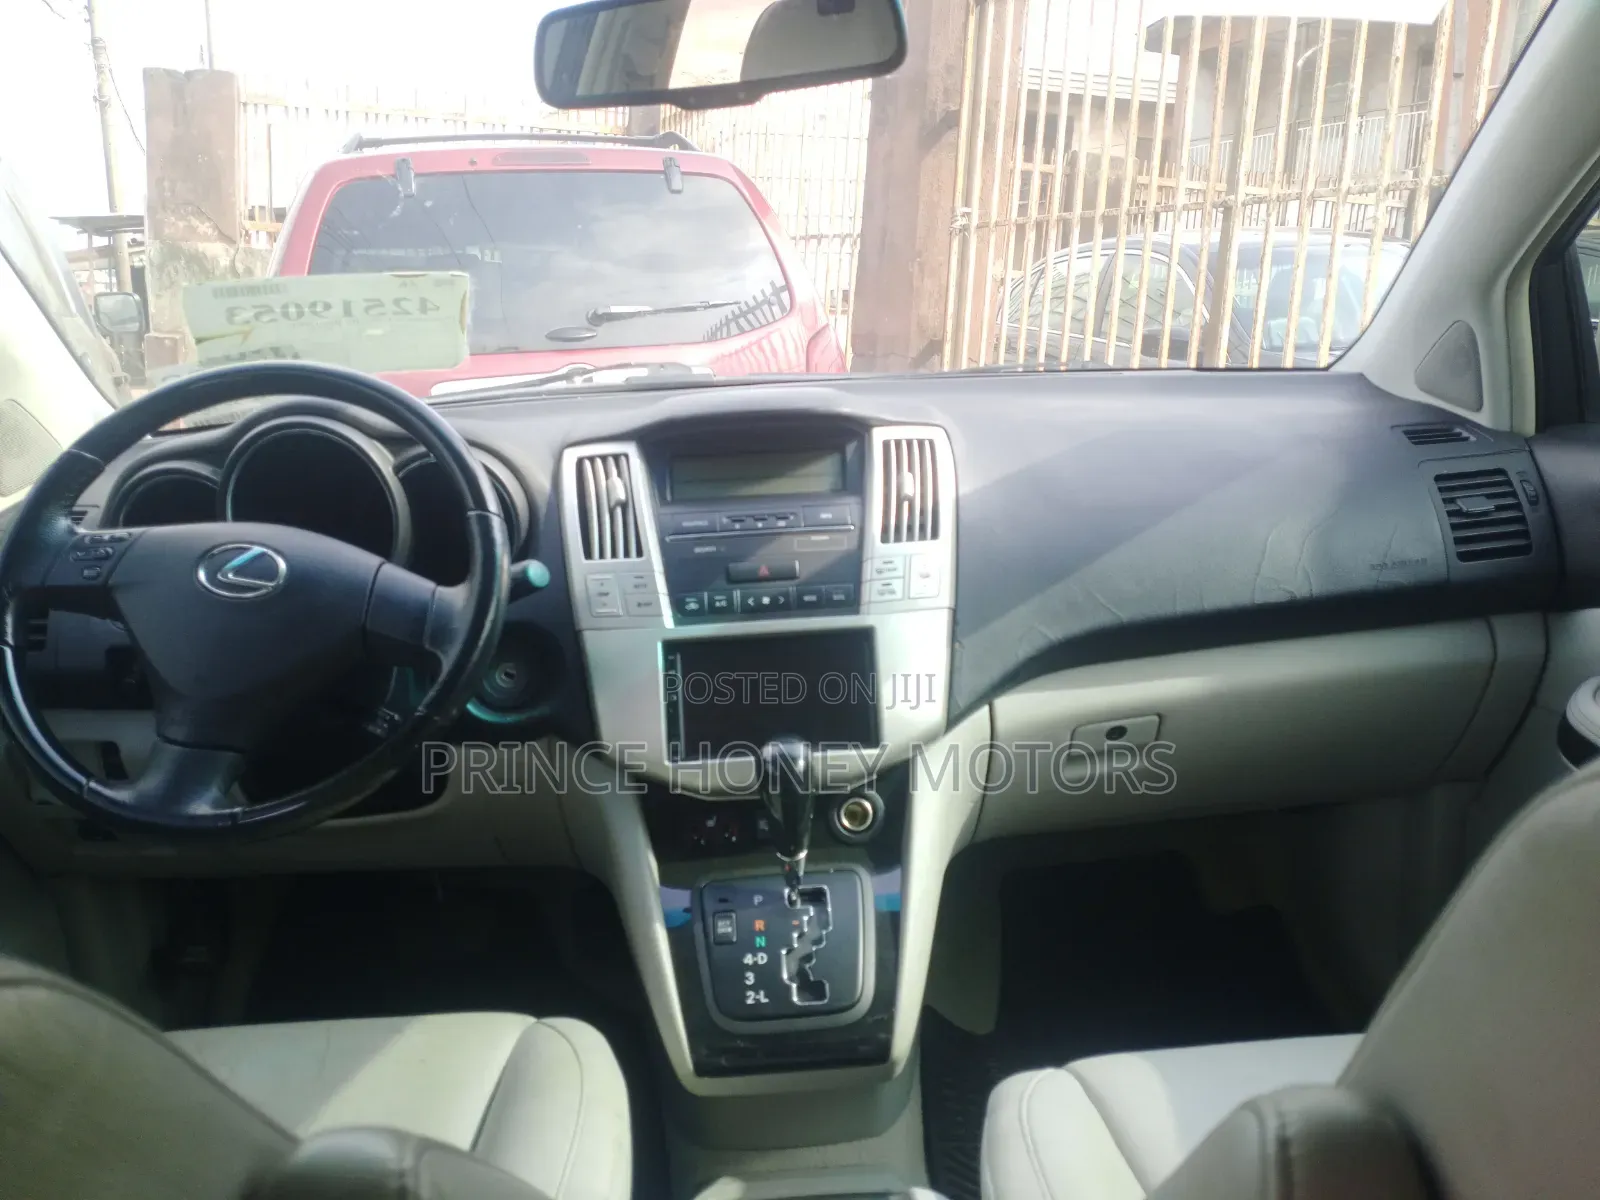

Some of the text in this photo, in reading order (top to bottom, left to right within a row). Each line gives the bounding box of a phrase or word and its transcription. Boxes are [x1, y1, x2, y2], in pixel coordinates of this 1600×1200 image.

[753, 894, 764, 906] P
[754, 919, 766, 932] R
[755, 936, 767, 948] N
[744, 971, 755, 985] 3
